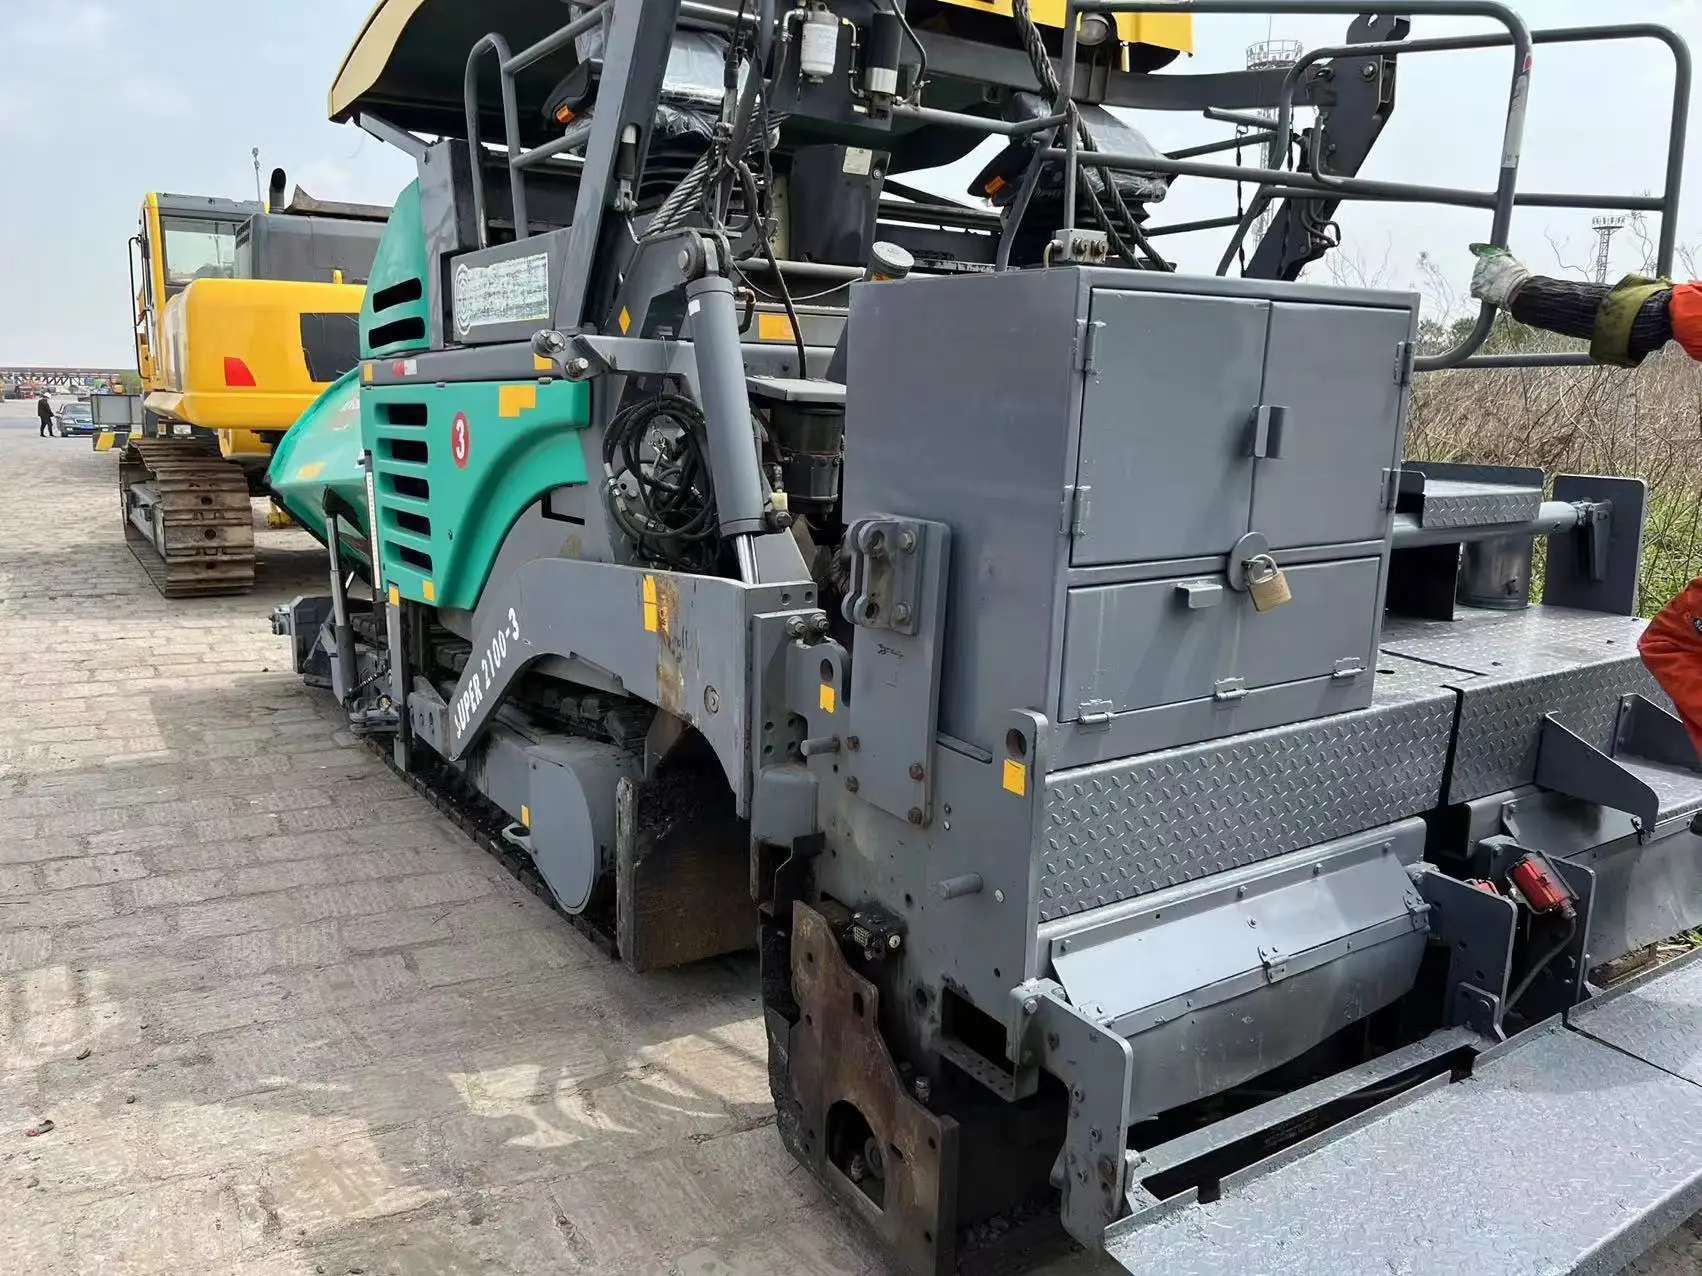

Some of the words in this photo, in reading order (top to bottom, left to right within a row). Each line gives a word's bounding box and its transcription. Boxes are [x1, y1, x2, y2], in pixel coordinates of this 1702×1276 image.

[455, 418, 465, 460] 3
[454, 673, 483, 739] SUPER
[481, 607, 520, 690] 2100-3
